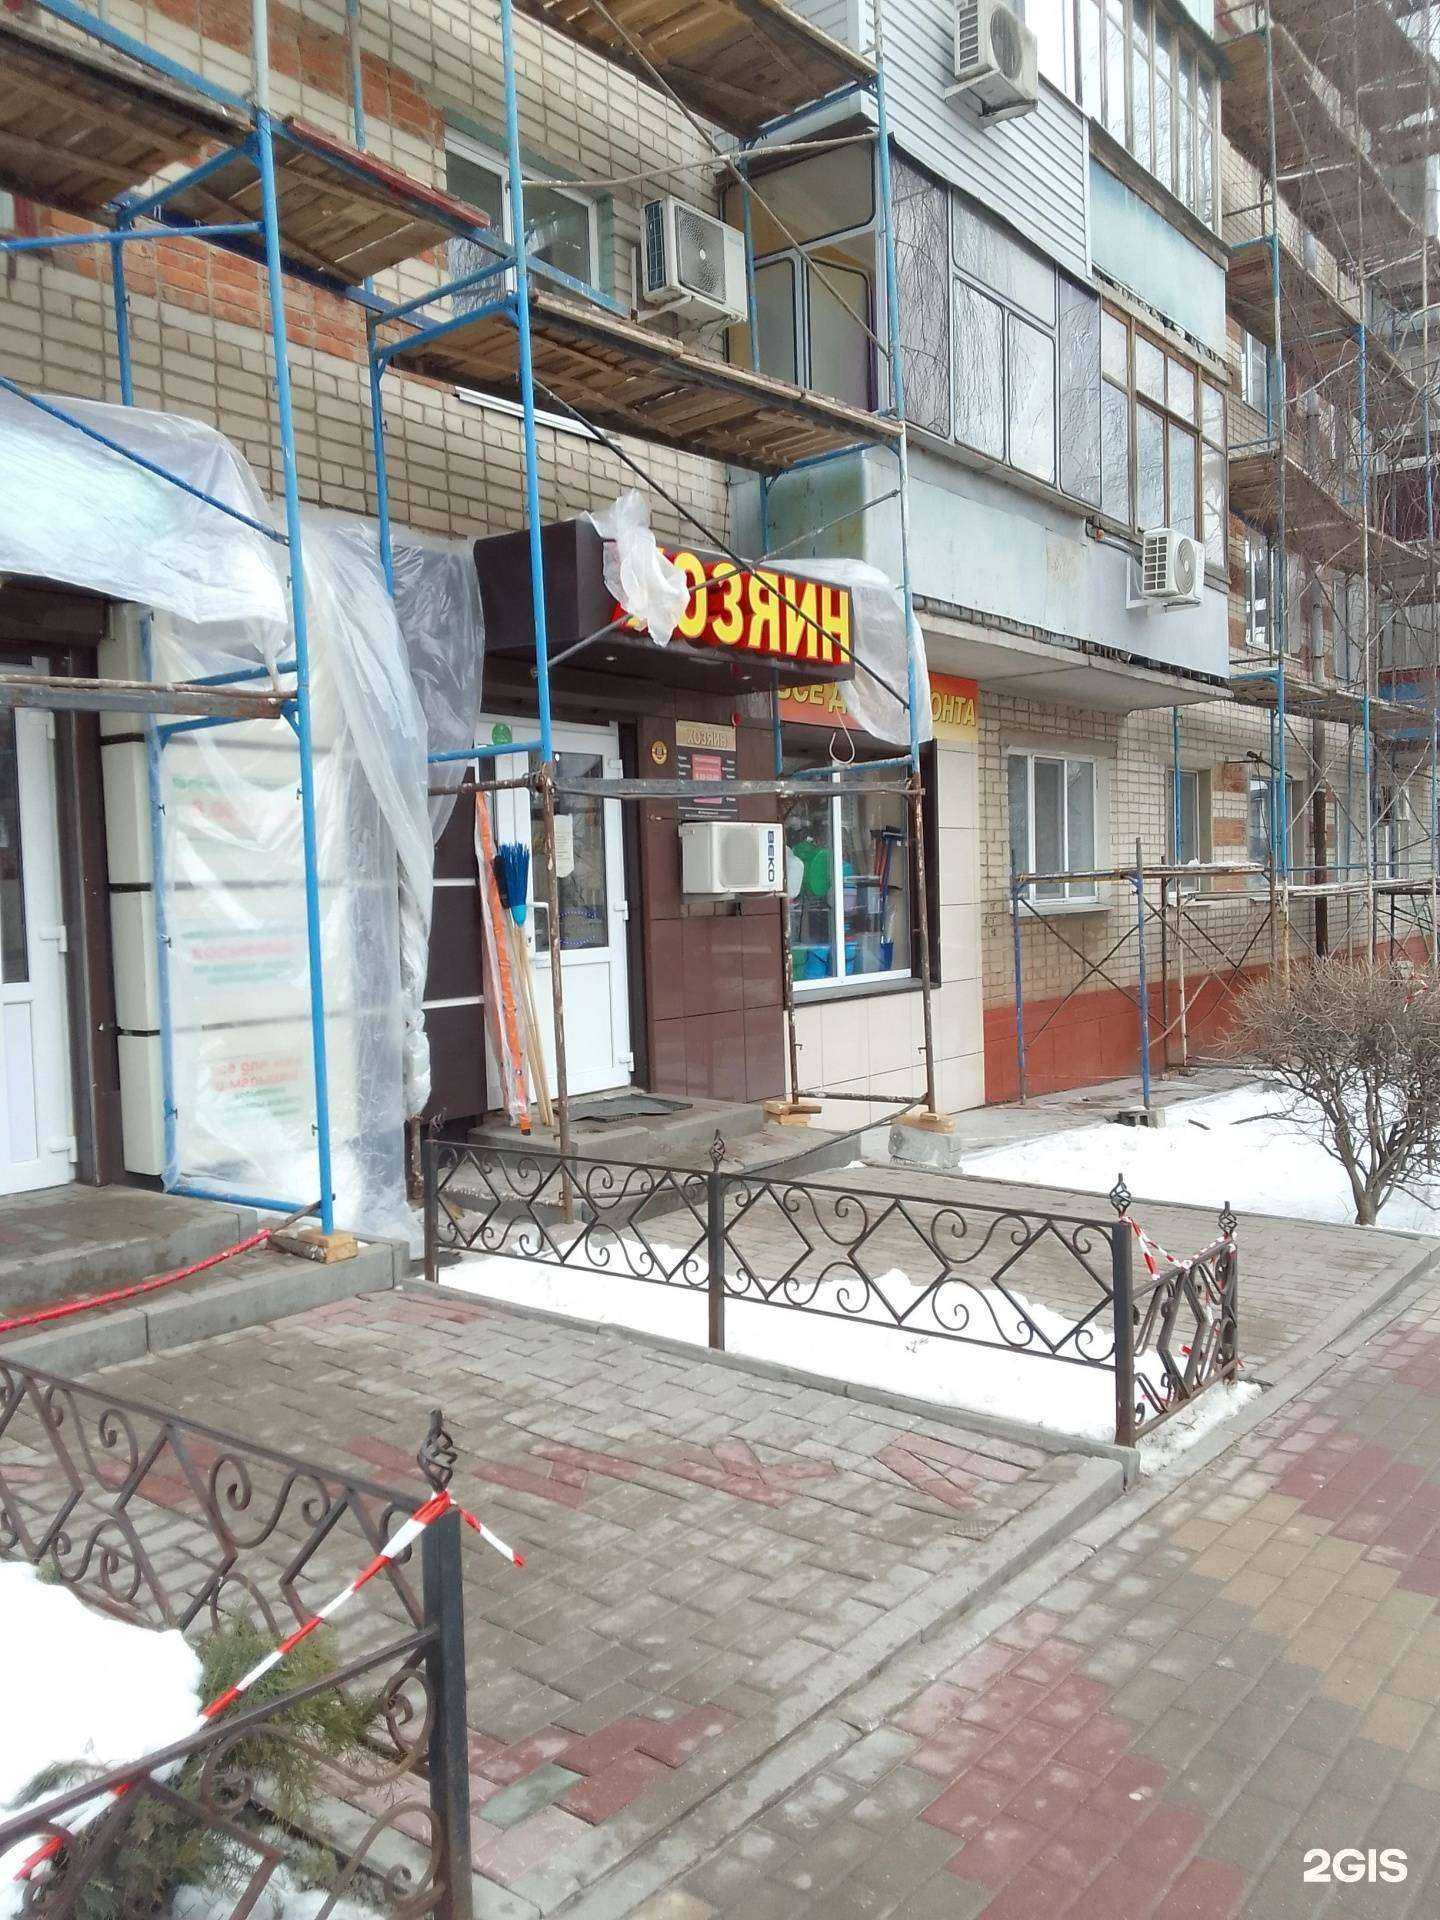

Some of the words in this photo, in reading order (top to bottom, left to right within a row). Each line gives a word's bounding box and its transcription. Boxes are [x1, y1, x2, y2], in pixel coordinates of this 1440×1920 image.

[627, 547, 851, 665] ОЗЯИН
[931, 691, 976, 727] ОНТА
[767, 830, 775, 882] BEKO
